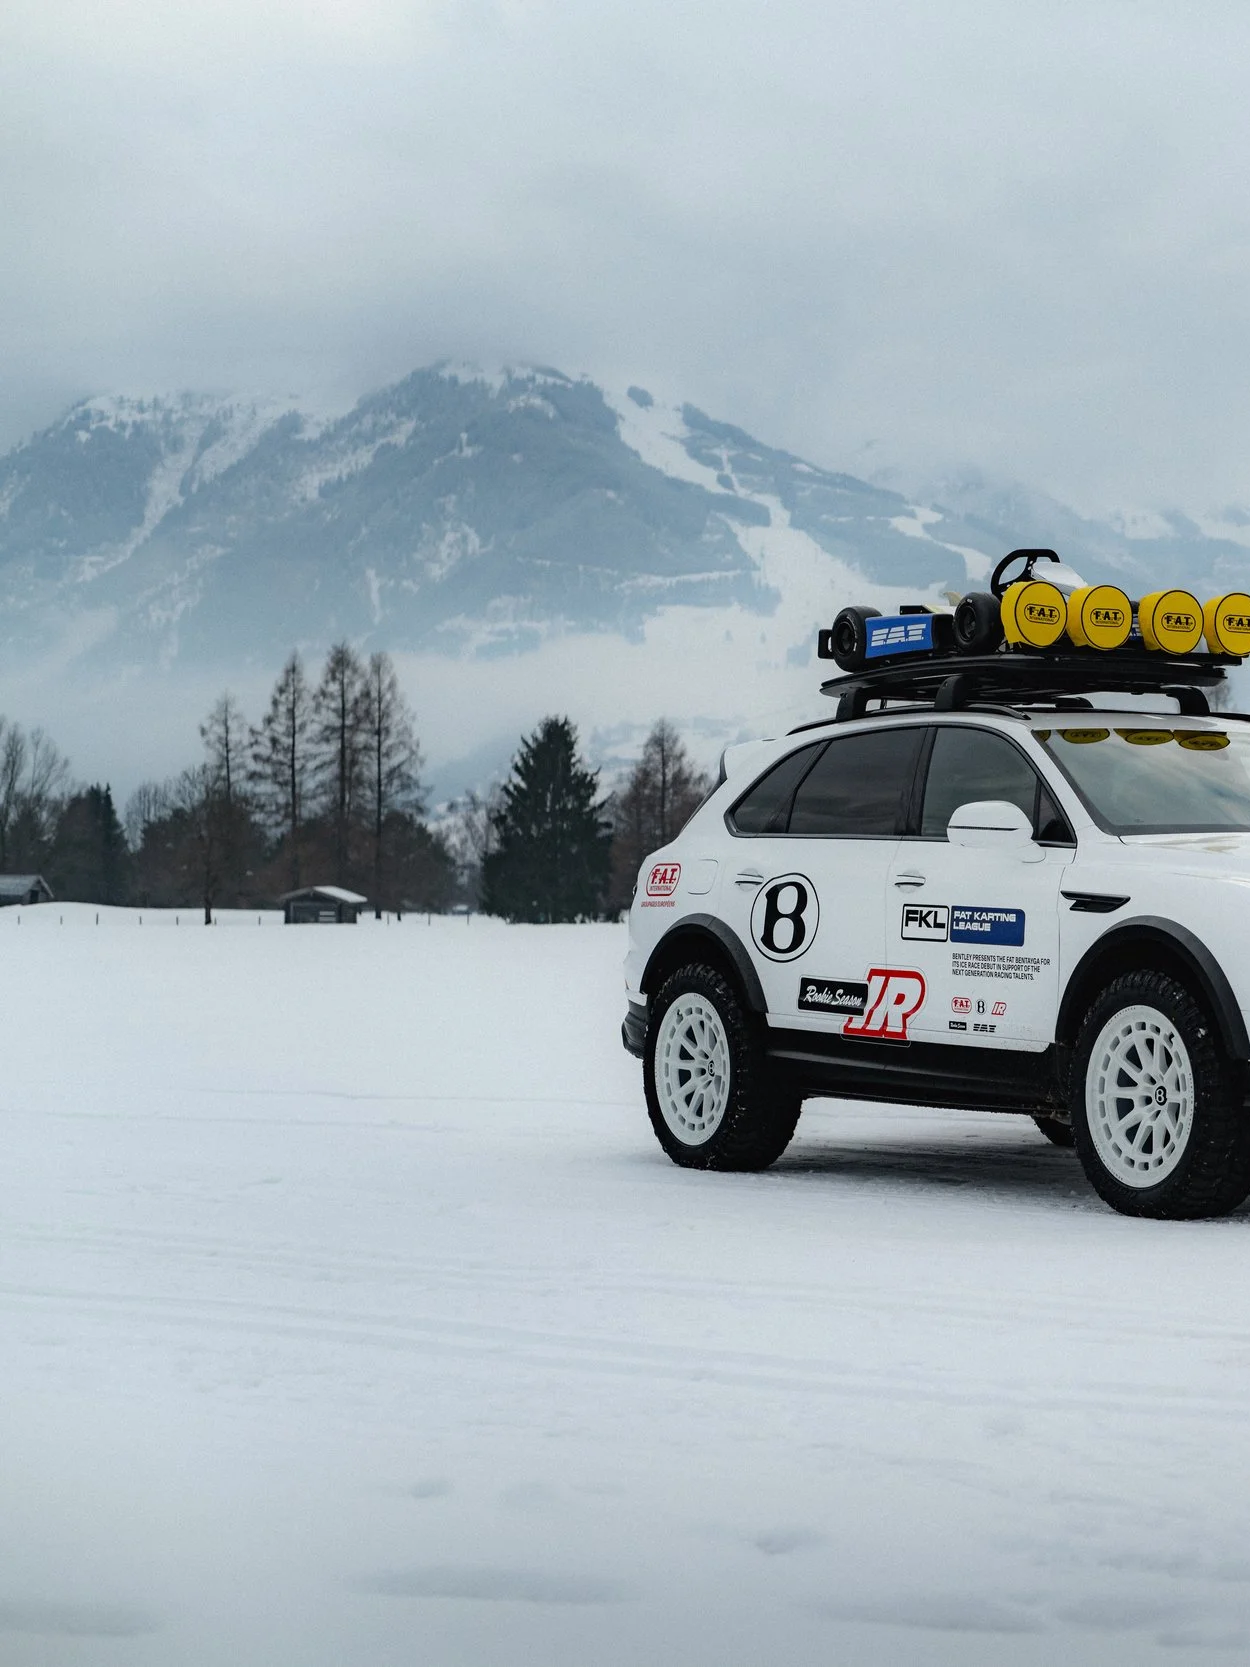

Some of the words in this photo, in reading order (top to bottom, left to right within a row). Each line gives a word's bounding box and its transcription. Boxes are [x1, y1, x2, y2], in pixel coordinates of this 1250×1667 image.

[905, 910, 945, 929] FKL
[954, 911, 972, 919] FAT
[974, 912, 1016, 922] KARTING
[953, 922, 991, 931] LEAGUE
[804, 985, 833, 1003] Rookie
[832, 988, 862, 1006] Season
